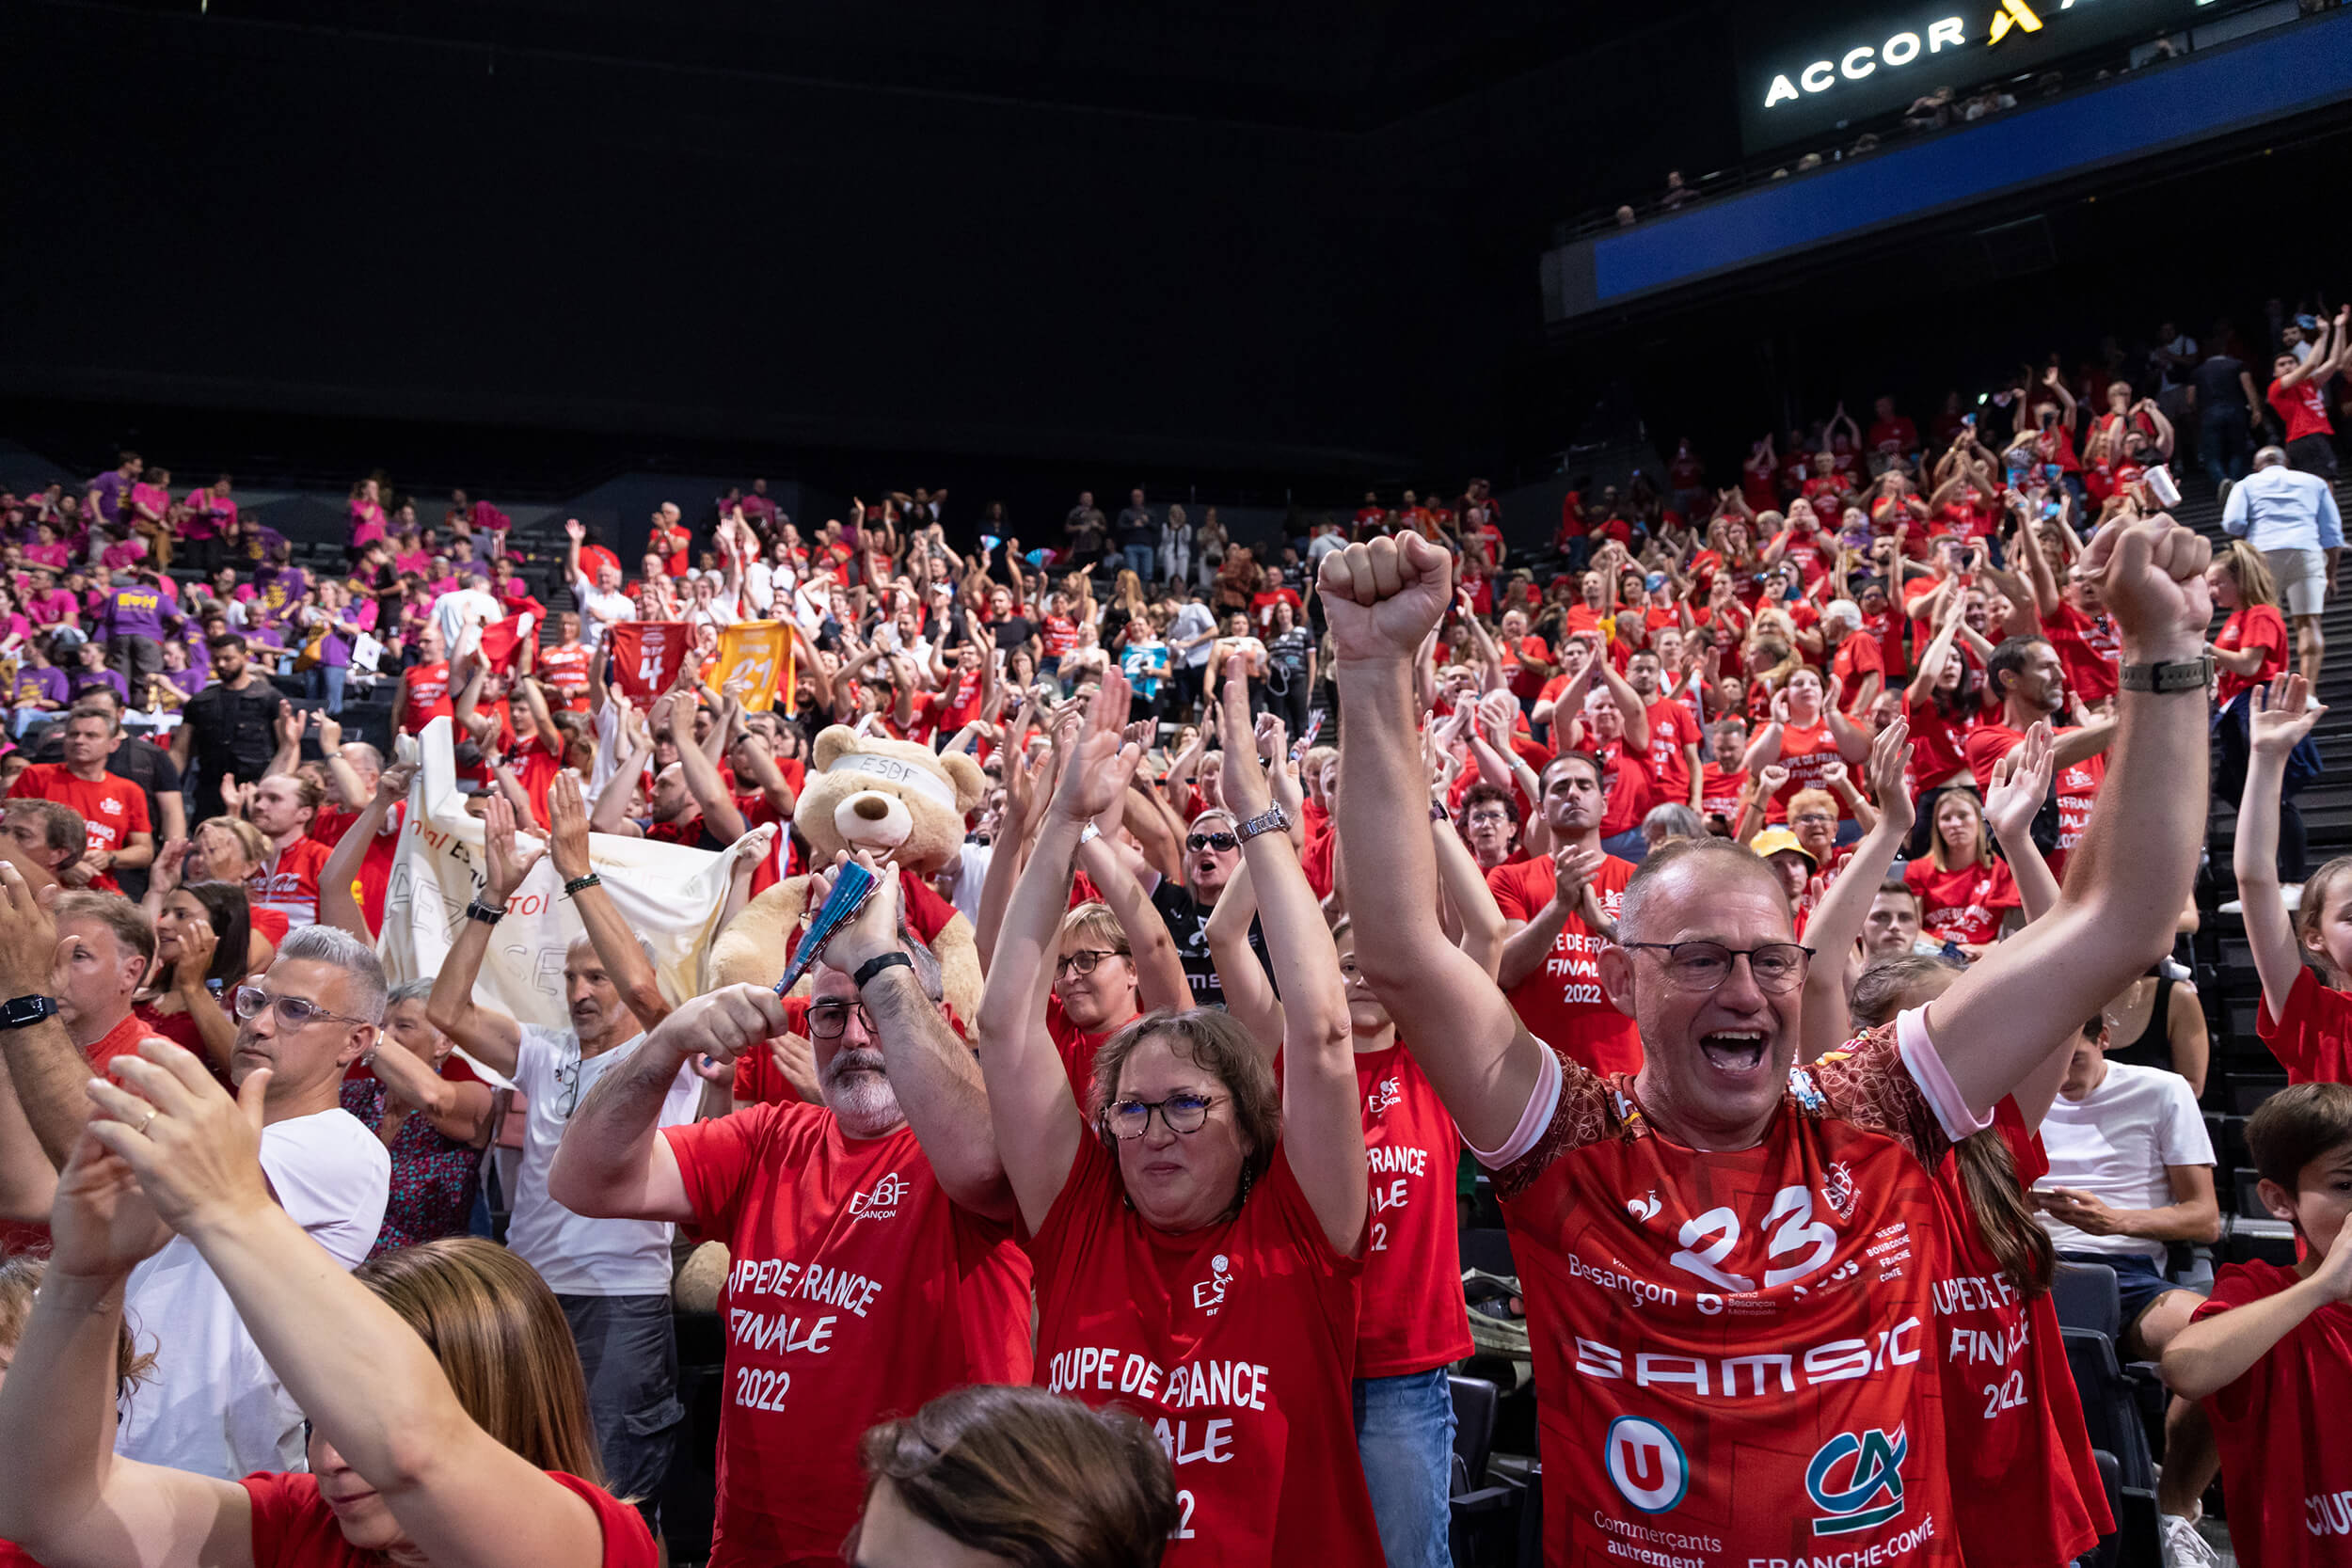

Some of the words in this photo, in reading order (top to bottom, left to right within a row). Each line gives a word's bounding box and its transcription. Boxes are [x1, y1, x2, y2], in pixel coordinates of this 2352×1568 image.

[1764, 16, 1965, 108] ACCOR
[639, 656, 664, 691] 4
[1565, 934, 1583, 953] DE
[1564, 984, 1601, 1004] 2022
[1670, 1185, 1837, 1293] 23
[768, 1259, 801, 1298] DE
[790, 1263, 882, 1318] RANCE
[1567, 1253, 1677, 1307] Besançon
[730, 1307, 837, 1356] FINALE
[1575, 1316, 1921, 1397] SAMSIC
[736, 1366, 790, 1413] 2022
[1120, 1354, 1164, 1399] DE
[1161, 1360, 1269, 1412] FRANCE
[1620, 1439, 1665, 1493] U
[1593, 1510, 1723, 1553] Commerçants
[1607, 1539, 1706, 1568] autrement
